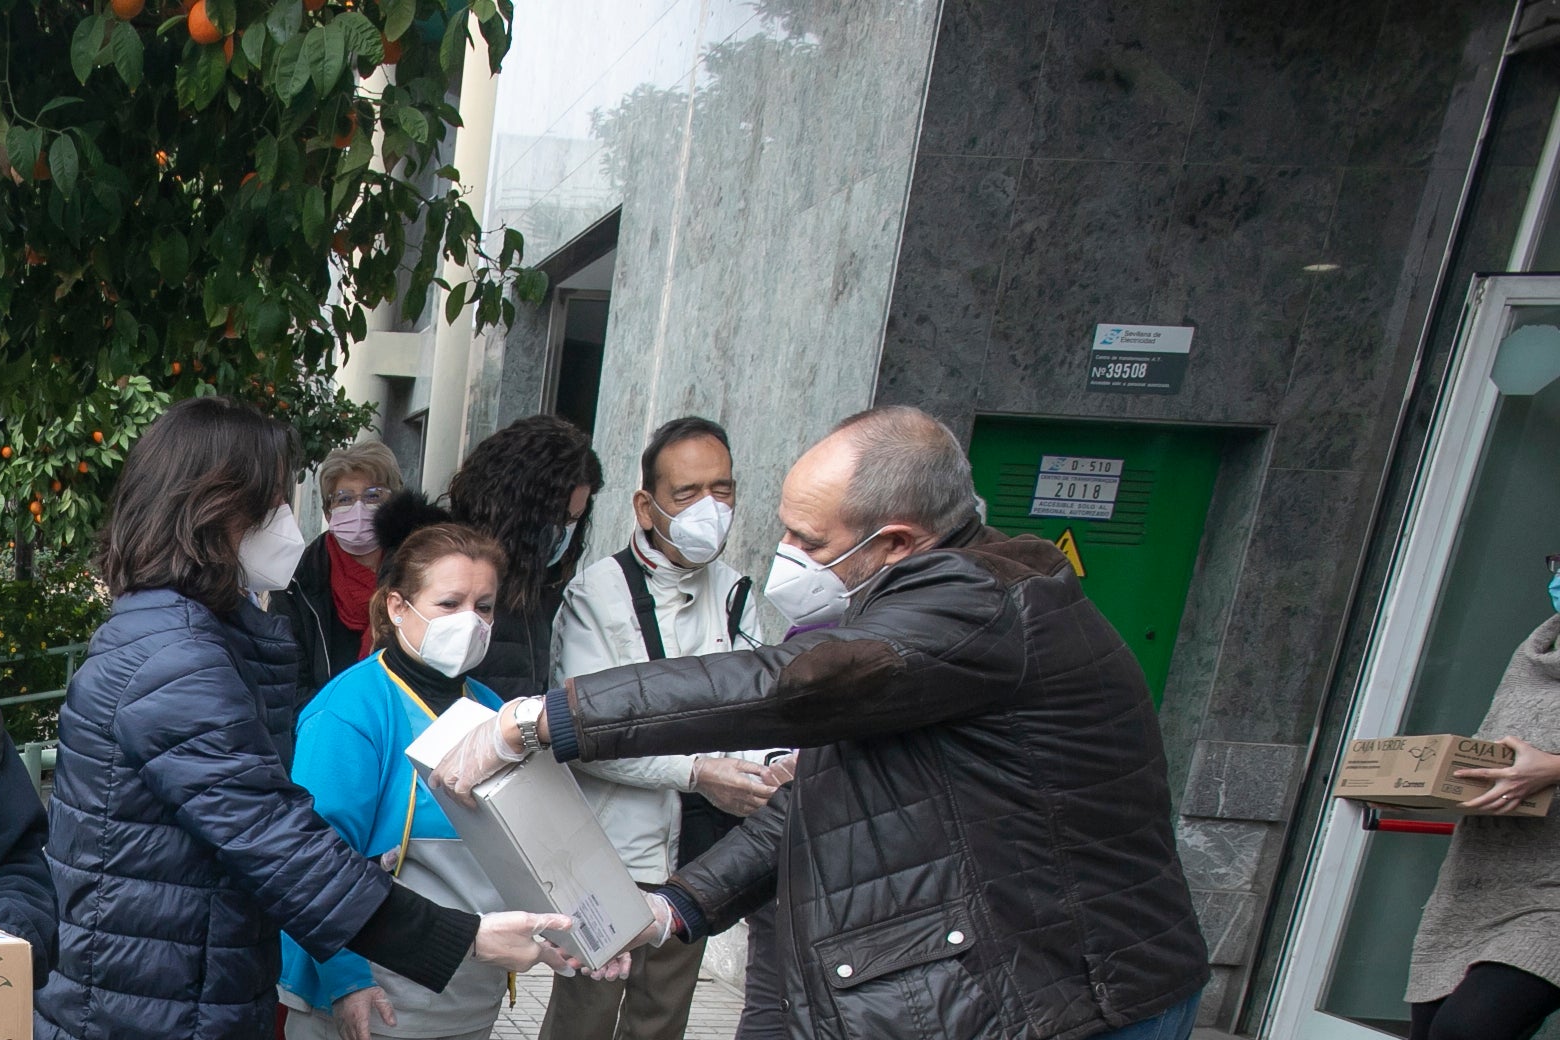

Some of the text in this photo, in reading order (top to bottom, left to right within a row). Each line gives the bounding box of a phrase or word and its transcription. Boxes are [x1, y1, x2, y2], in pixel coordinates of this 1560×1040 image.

[1124, 330, 1152, 338] Sevillana
[1054, 482, 1101, 499] 2018
[1033, 507, 1067, 515] PERSONAL
[1352, 739, 1406, 752] CAJA VERDE
[1458, 740, 1495, 757] CAJA
